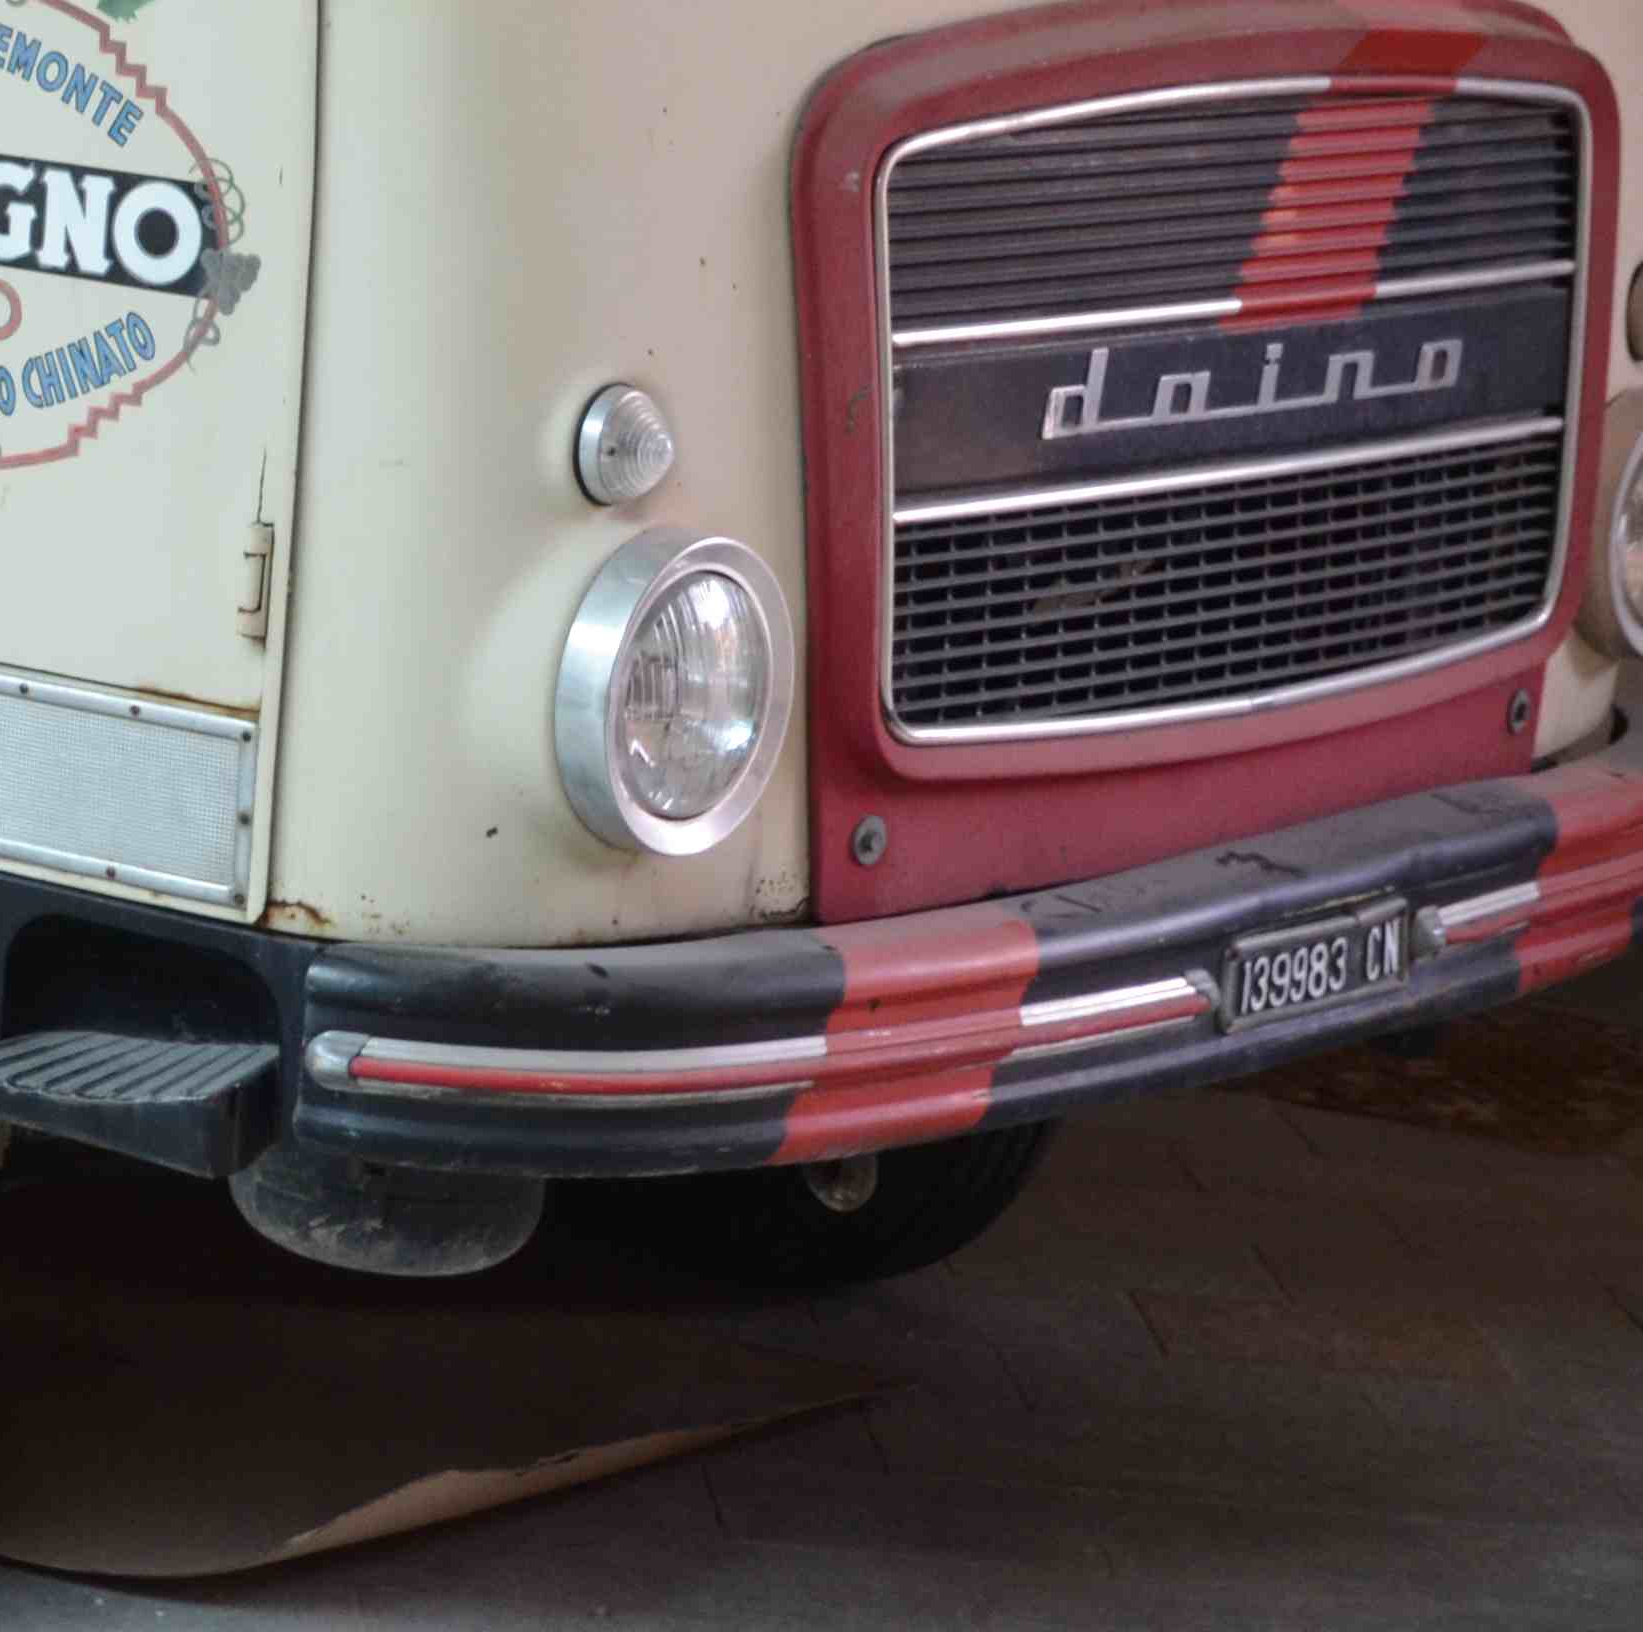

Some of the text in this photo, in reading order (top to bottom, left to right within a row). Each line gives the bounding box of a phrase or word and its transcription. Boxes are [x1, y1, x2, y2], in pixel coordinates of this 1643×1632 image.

[21, 310, 158, 410] CHINATO
[1041, 338, 1464, 441] daino
[1240, 918, 1400, 1015] 139983 CN
